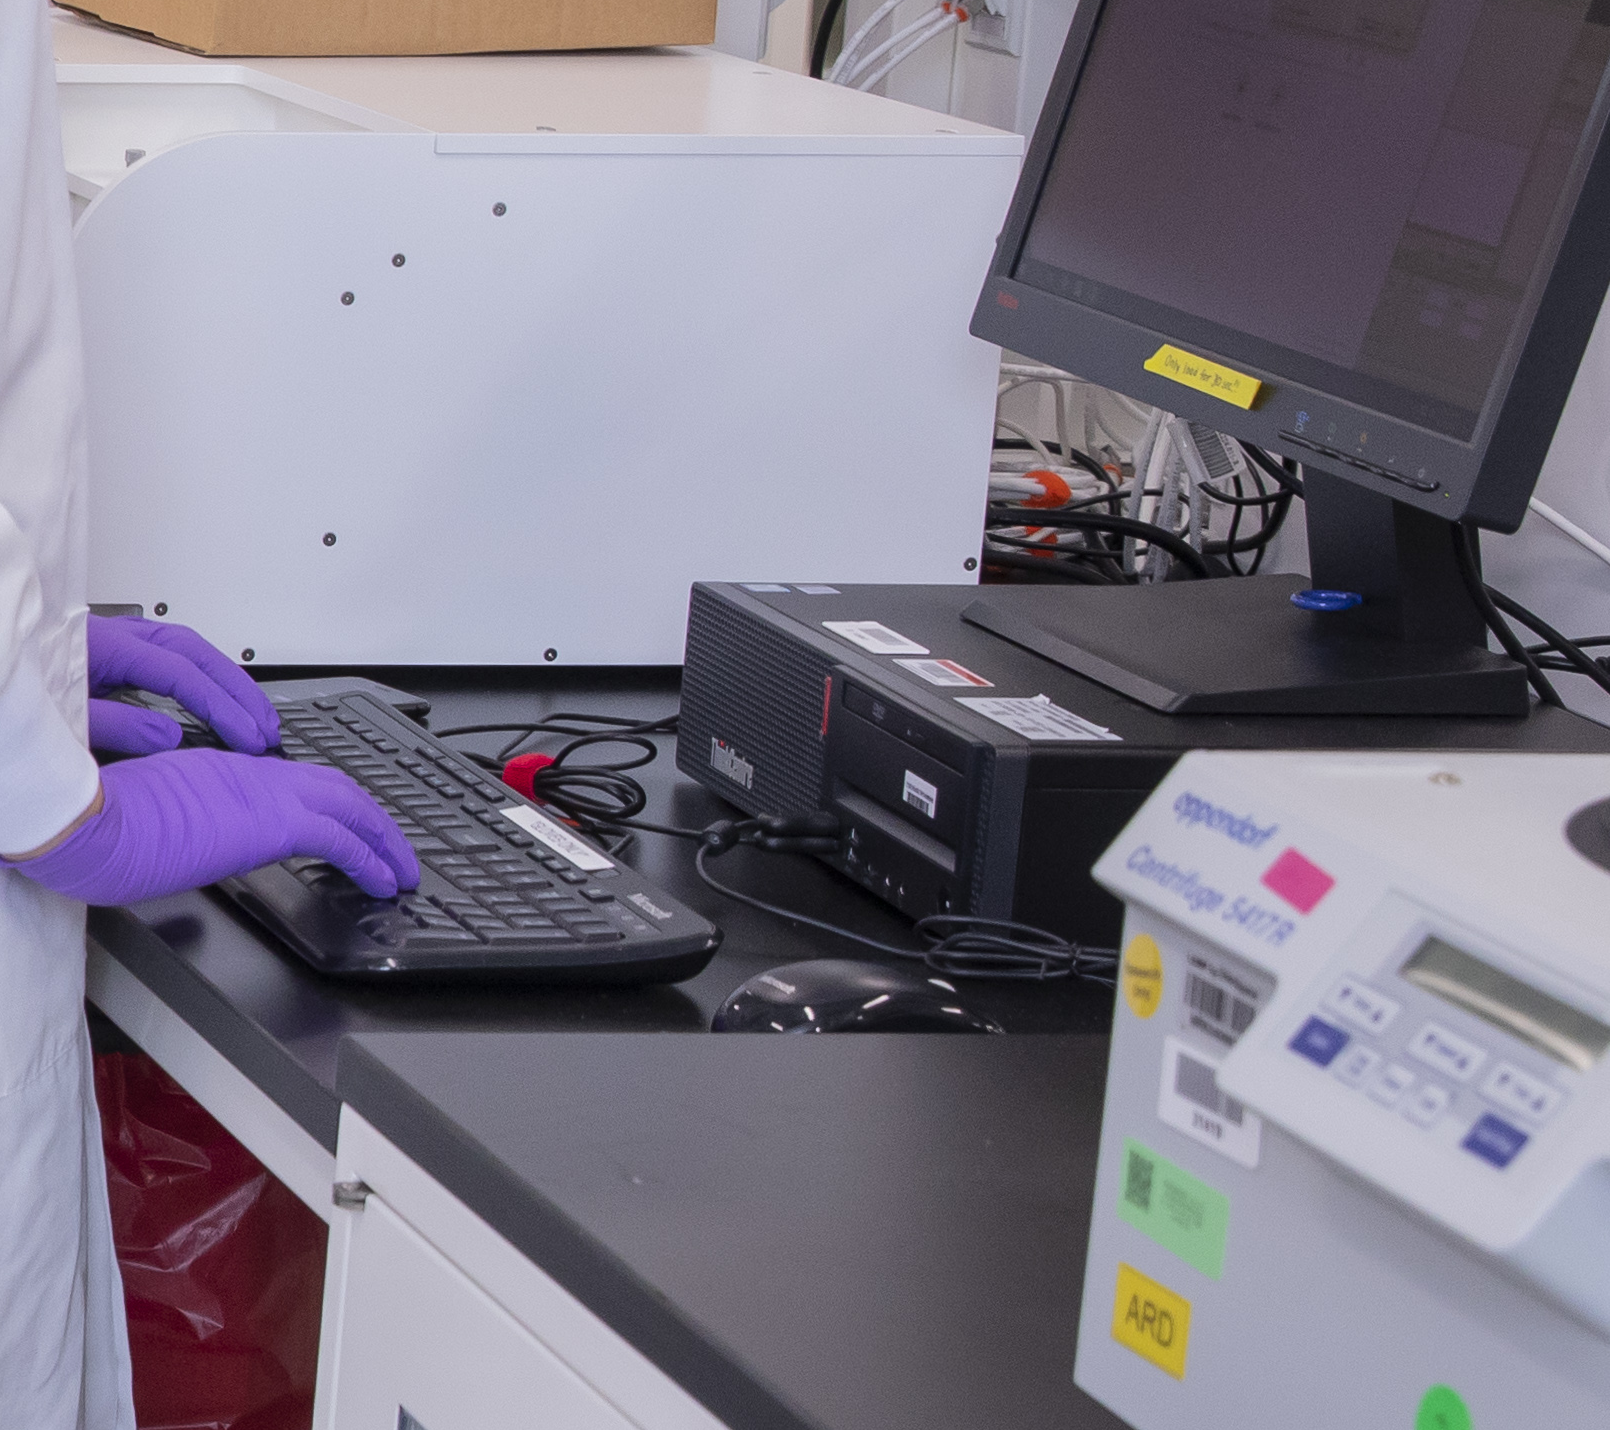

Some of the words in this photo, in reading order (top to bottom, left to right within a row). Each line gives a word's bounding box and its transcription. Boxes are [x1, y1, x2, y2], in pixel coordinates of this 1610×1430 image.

[1164, 354, 1181, 375] Only
[1173, 791, 1280, 849] eppendorf
[1126, 843, 1225, 913] Centrifuge
[1125, 1293, 1175, 1349] ARD
